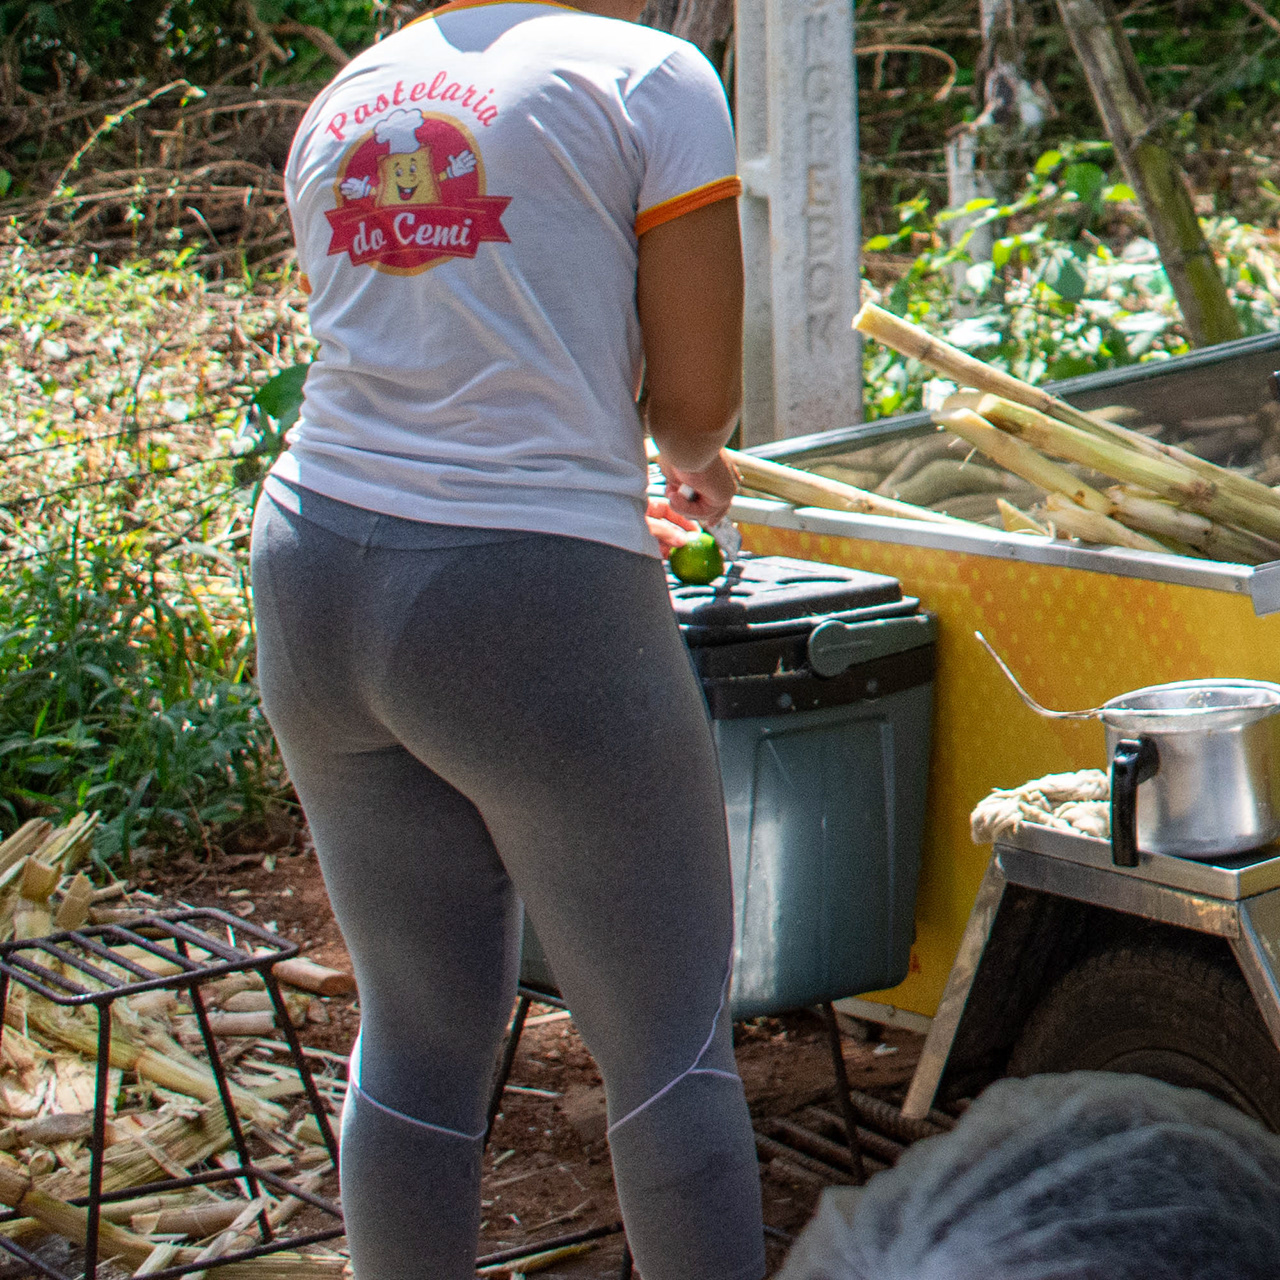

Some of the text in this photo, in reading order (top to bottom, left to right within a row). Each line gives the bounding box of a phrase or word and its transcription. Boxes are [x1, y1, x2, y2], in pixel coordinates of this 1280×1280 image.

[324, 70, 500, 142] Pastelaria
[353, 212, 473, 256] do Cemi
